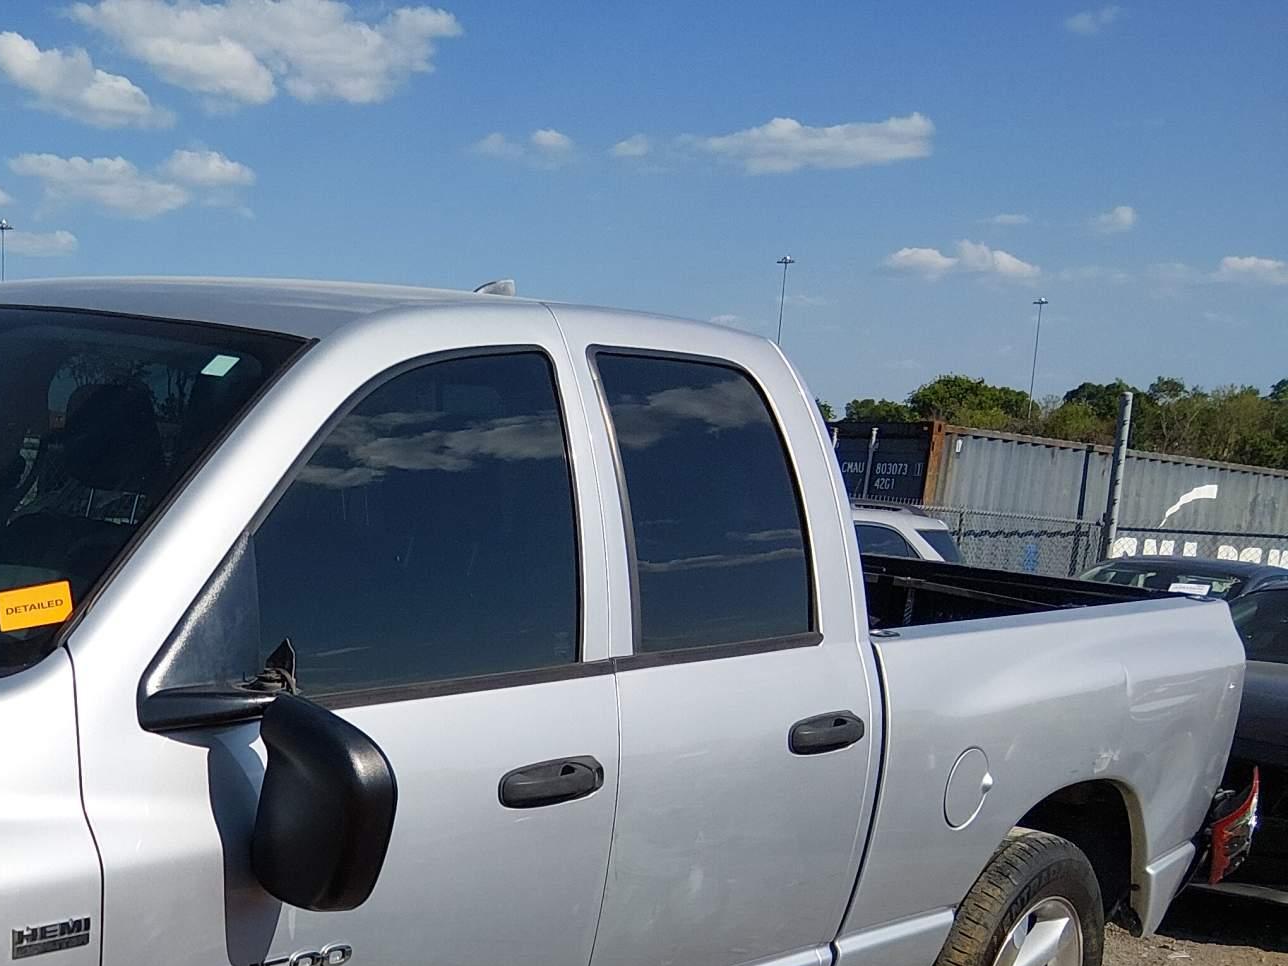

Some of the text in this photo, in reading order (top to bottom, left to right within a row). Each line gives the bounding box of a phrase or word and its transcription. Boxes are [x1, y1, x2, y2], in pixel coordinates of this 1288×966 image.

[841, 461, 865, 473] CMAU
[875, 462, 908, 476] 803073
[5, 597, 64, 617] DETAILED
[11, 915, 91, 946] HEMI
